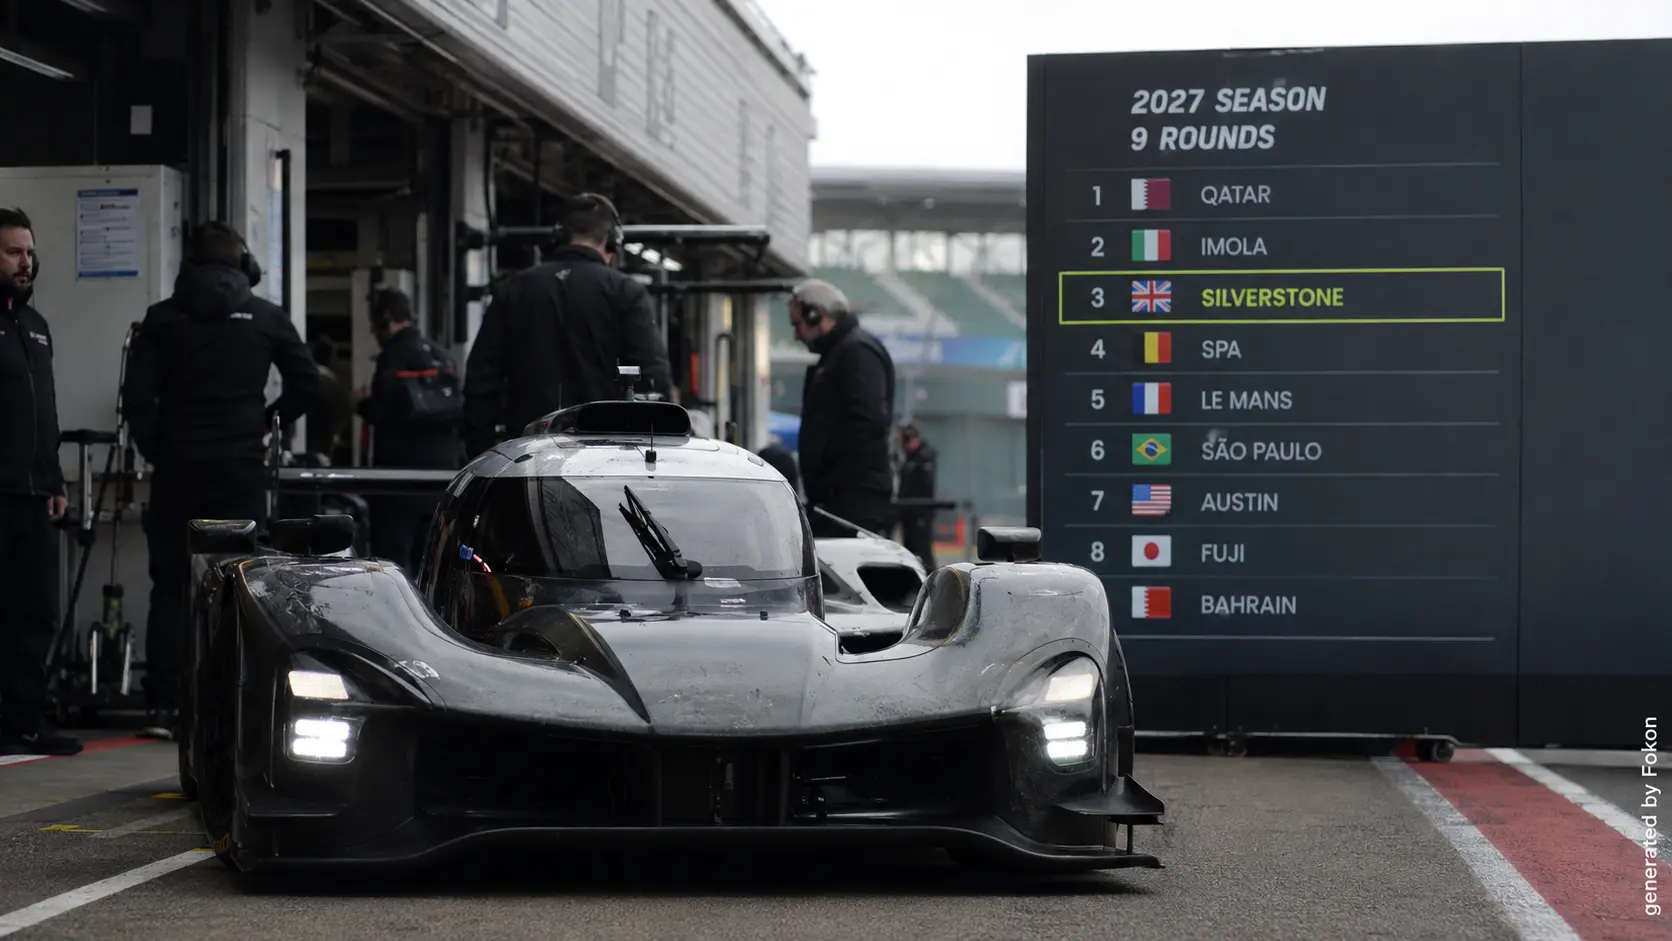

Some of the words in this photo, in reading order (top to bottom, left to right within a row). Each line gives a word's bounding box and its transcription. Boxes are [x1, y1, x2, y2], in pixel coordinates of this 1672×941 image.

[1131, 88, 1205, 115] 2027
[1215, 86, 1327, 113] SEASON
[1131, 126, 1148, 151] 9
[1160, 123, 1276, 150] ROUNDS
[1093, 185, 1101, 206] 1
[1201, 184, 1271, 206] QATAR
[1091, 236, 1105, 257] 2
[1201, 236, 1268, 256] IMOLA
[1091, 287, 1105, 308] 3
[1201, 287, 1344, 308] SILVERSTONE
[1090, 338, 1106, 359] 4
[1201, 339, 1242, 359] SPA
[1091, 389, 1105, 410] 5
[1201, 390, 1223, 410] LE
[1229, 390, 1293, 410] MANS
[1090, 440, 1105, 461] 6
[1201, 437, 1247, 461] SÃO
[1252, 441, 1322, 461] PAULO
[1091, 491, 1105, 512] 7
[1201, 492, 1279, 512] AUSTIN
[1090, 541, 1105, 562] 8
[1201, 543, 1245, 563] FUJI
[1201, 595, 1297, 615] BAHRAIN
